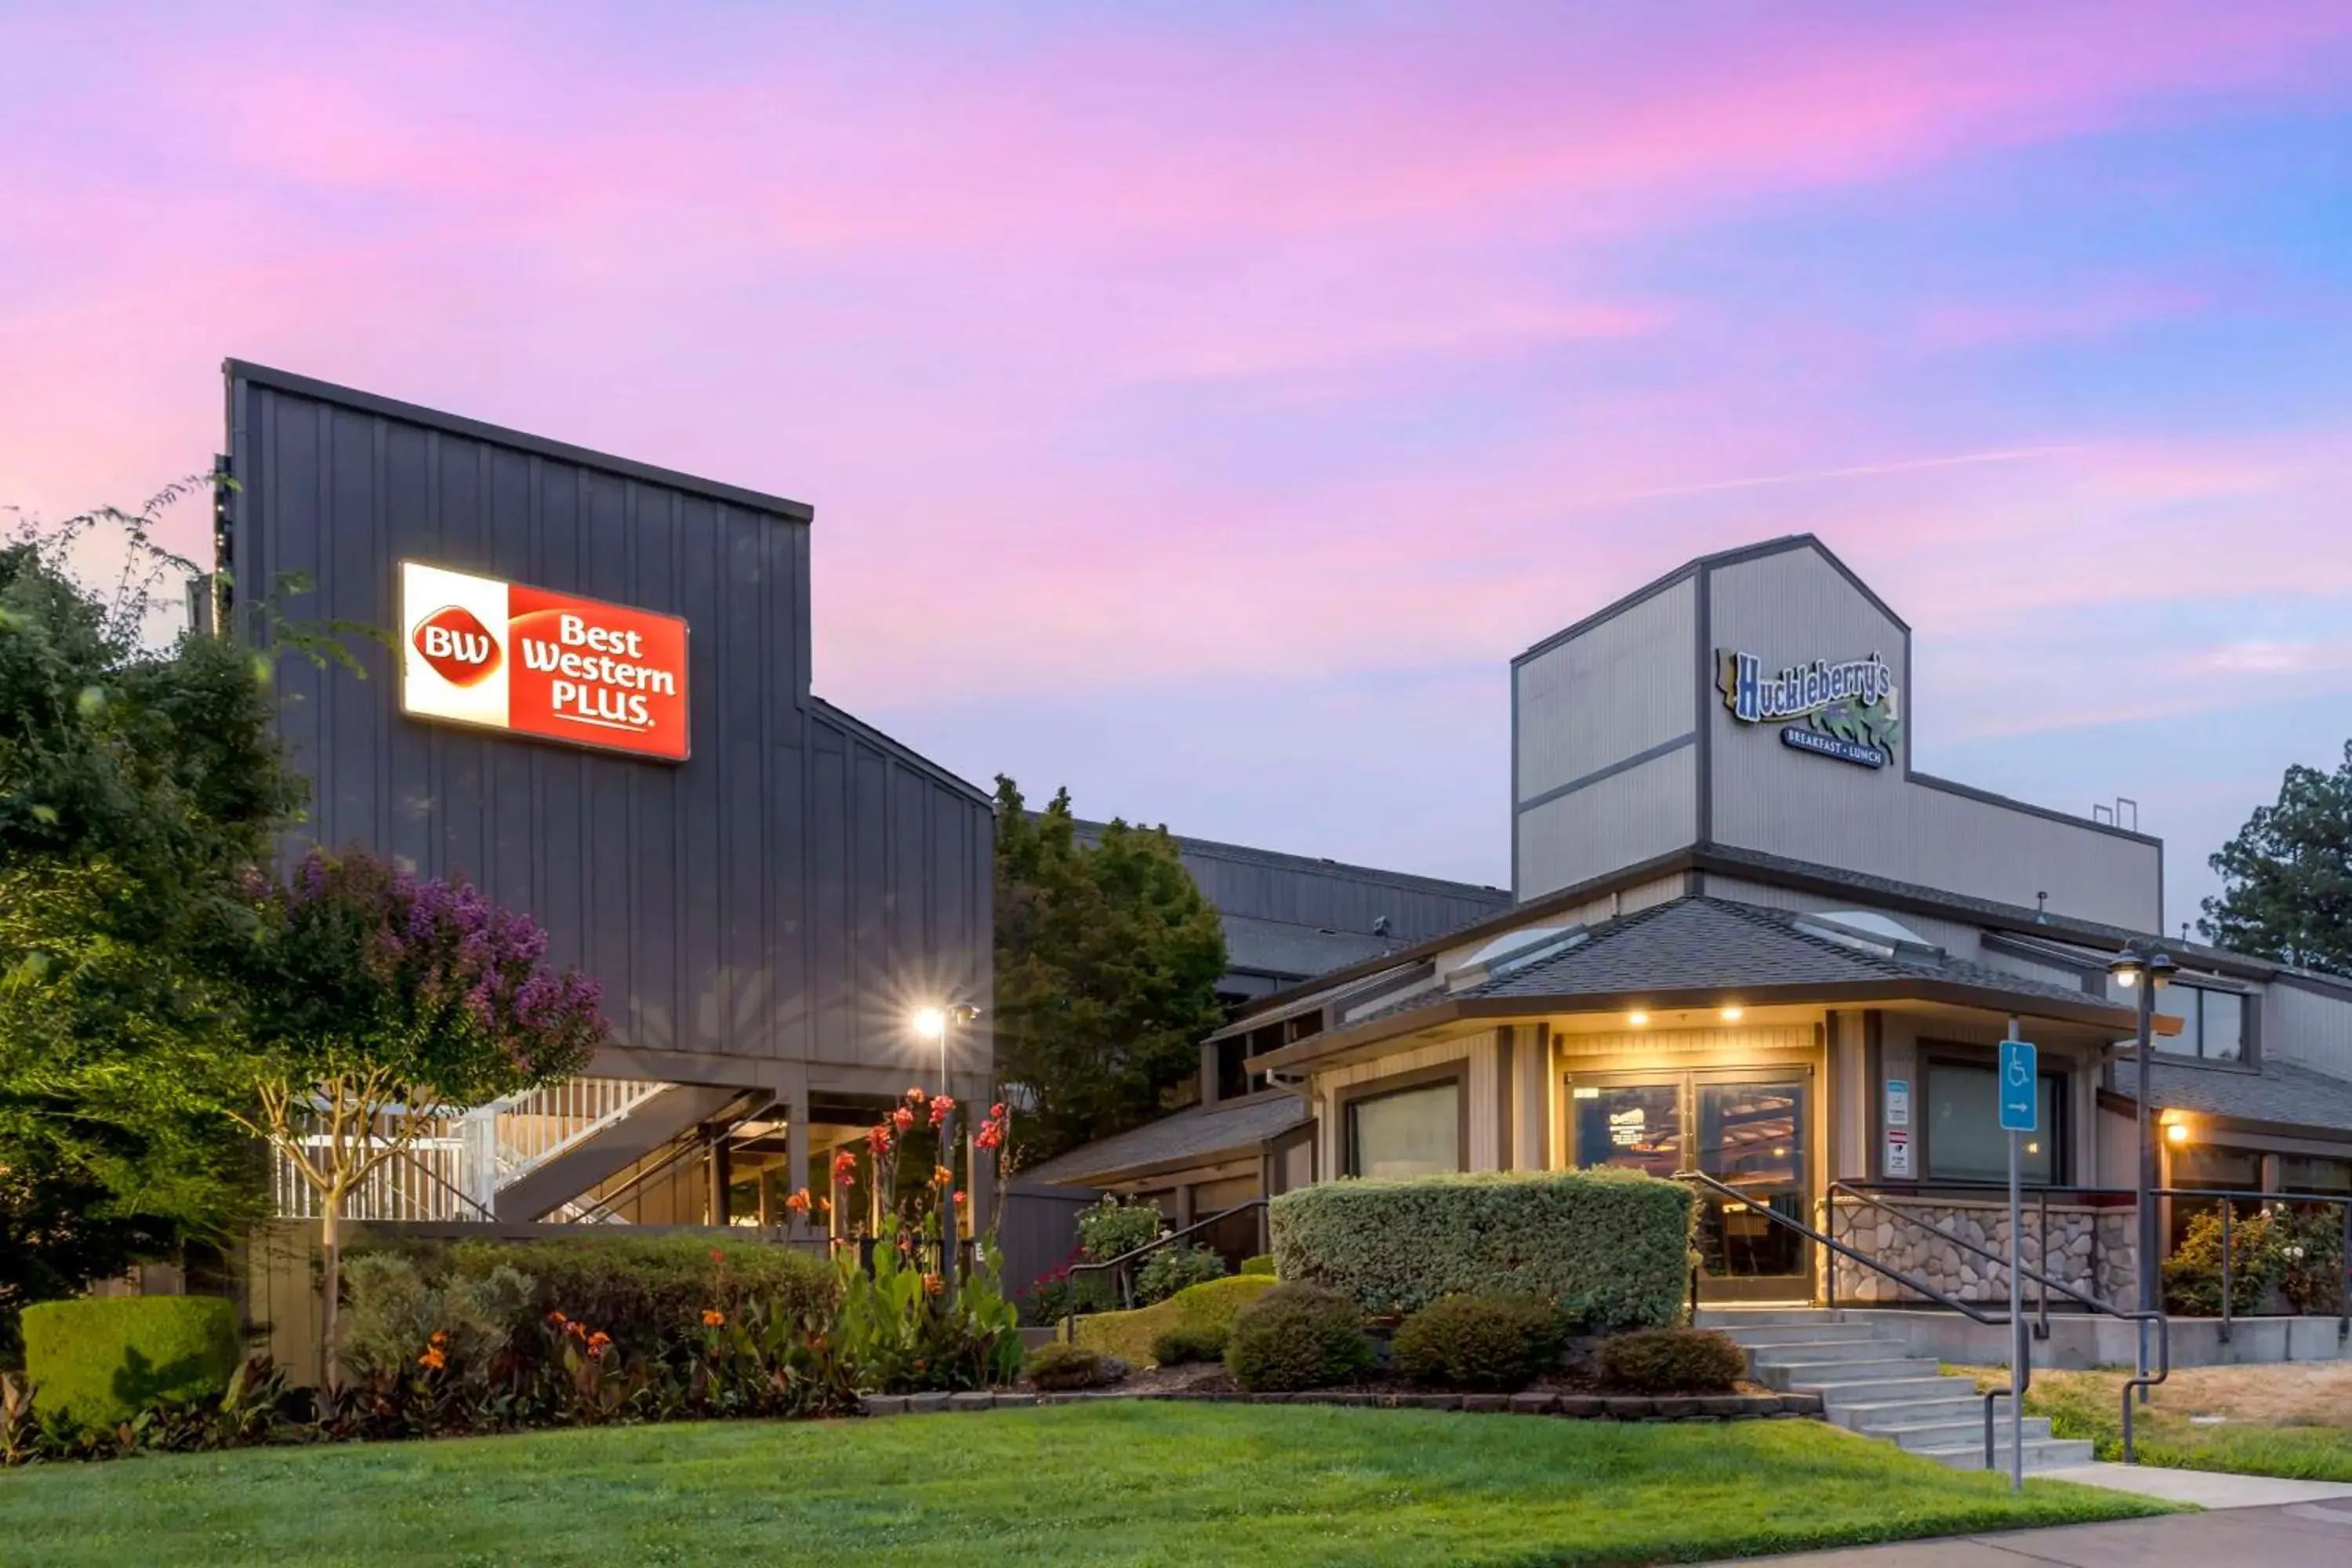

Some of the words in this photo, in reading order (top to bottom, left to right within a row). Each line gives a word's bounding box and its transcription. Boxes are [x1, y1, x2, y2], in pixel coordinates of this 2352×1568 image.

[425, 626, 489, 664] BW
[560, 614, 643, 659] Best
[521, 637, 676, 695] Western
[1736, 651, 1890, 721] Huckleberry's
[1788, 729, 1842, 753] BREAKFAST
[1849, 746, 1882, 763] LUNCH
